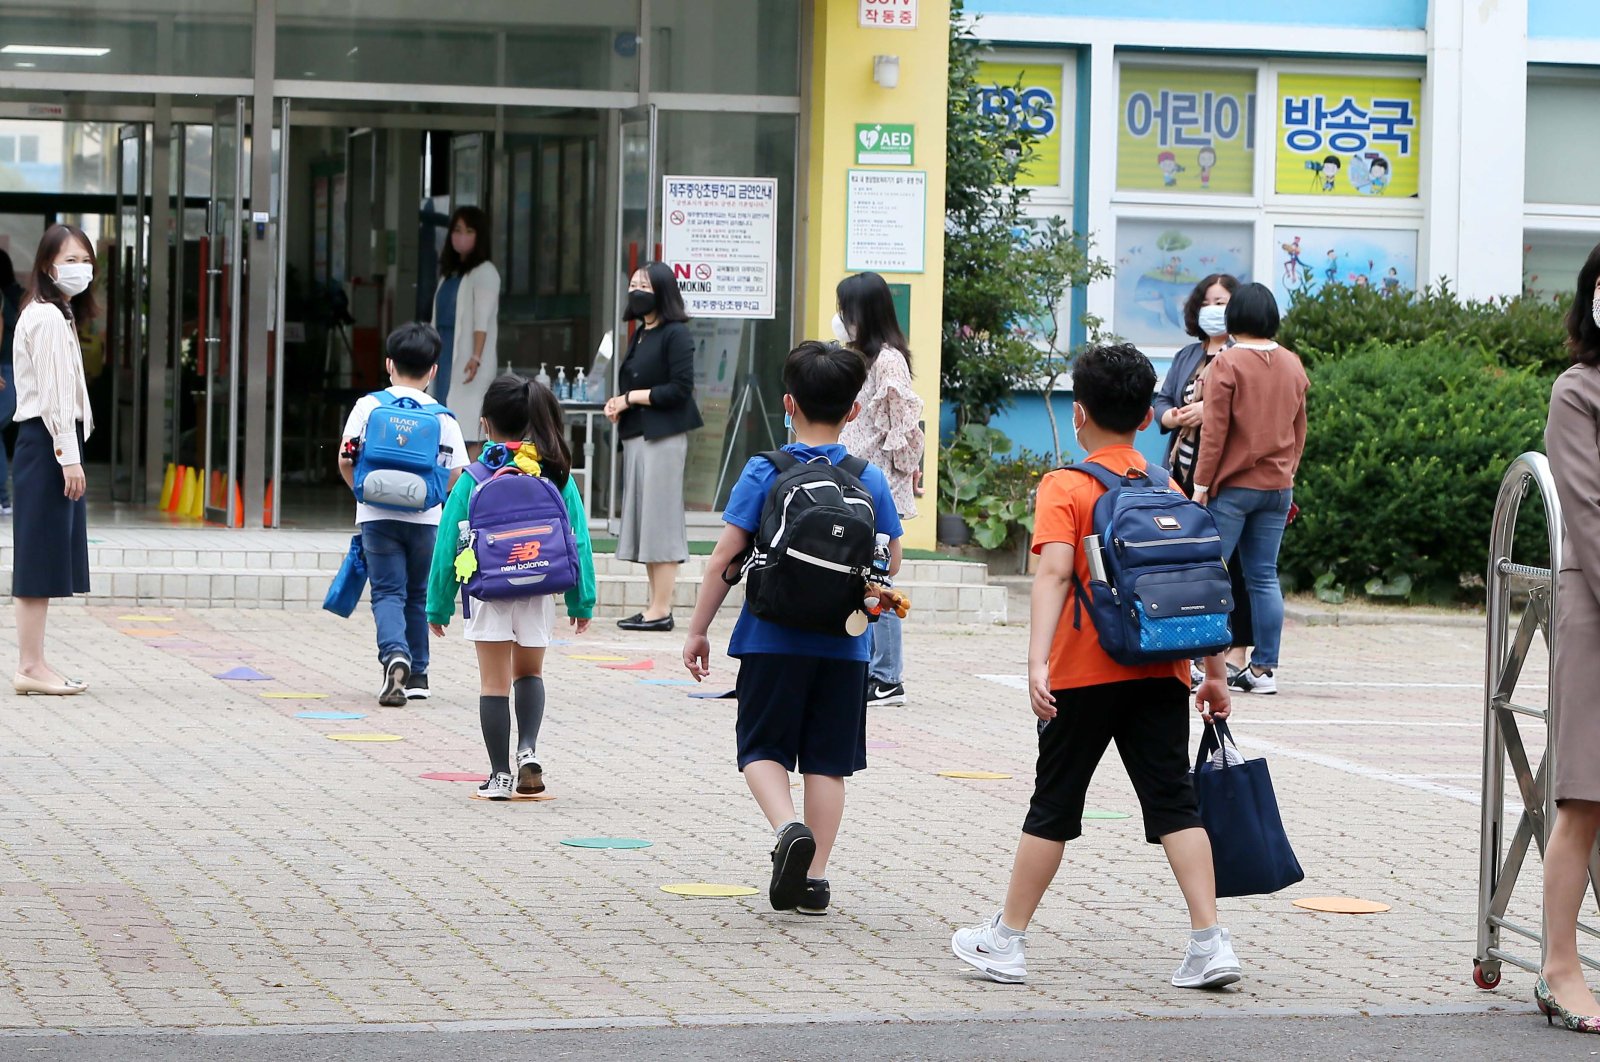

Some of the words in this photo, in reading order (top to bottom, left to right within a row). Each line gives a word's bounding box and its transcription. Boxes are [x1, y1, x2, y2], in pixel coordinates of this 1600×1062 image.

[966, 87, 1055, 135] BS
[1127, 91, 1256, 149] 어린이
[1285, 97, 1414, 154] 방송국
[880, 132, 911, 146] AED
[669, 183, 736, 199] 제주중앙초등학교
[739, 184, 772, 199] 금연안내
[678, 281, 712, 292] MOKING
[693, 300, 759, 310] 제주중앙초등학교
[390, 416, 418, 426] BLACK
[396, 424, 412, 432] YAK
[501, 564, 516, 572] new
[517, 560, 549, 570] balance
